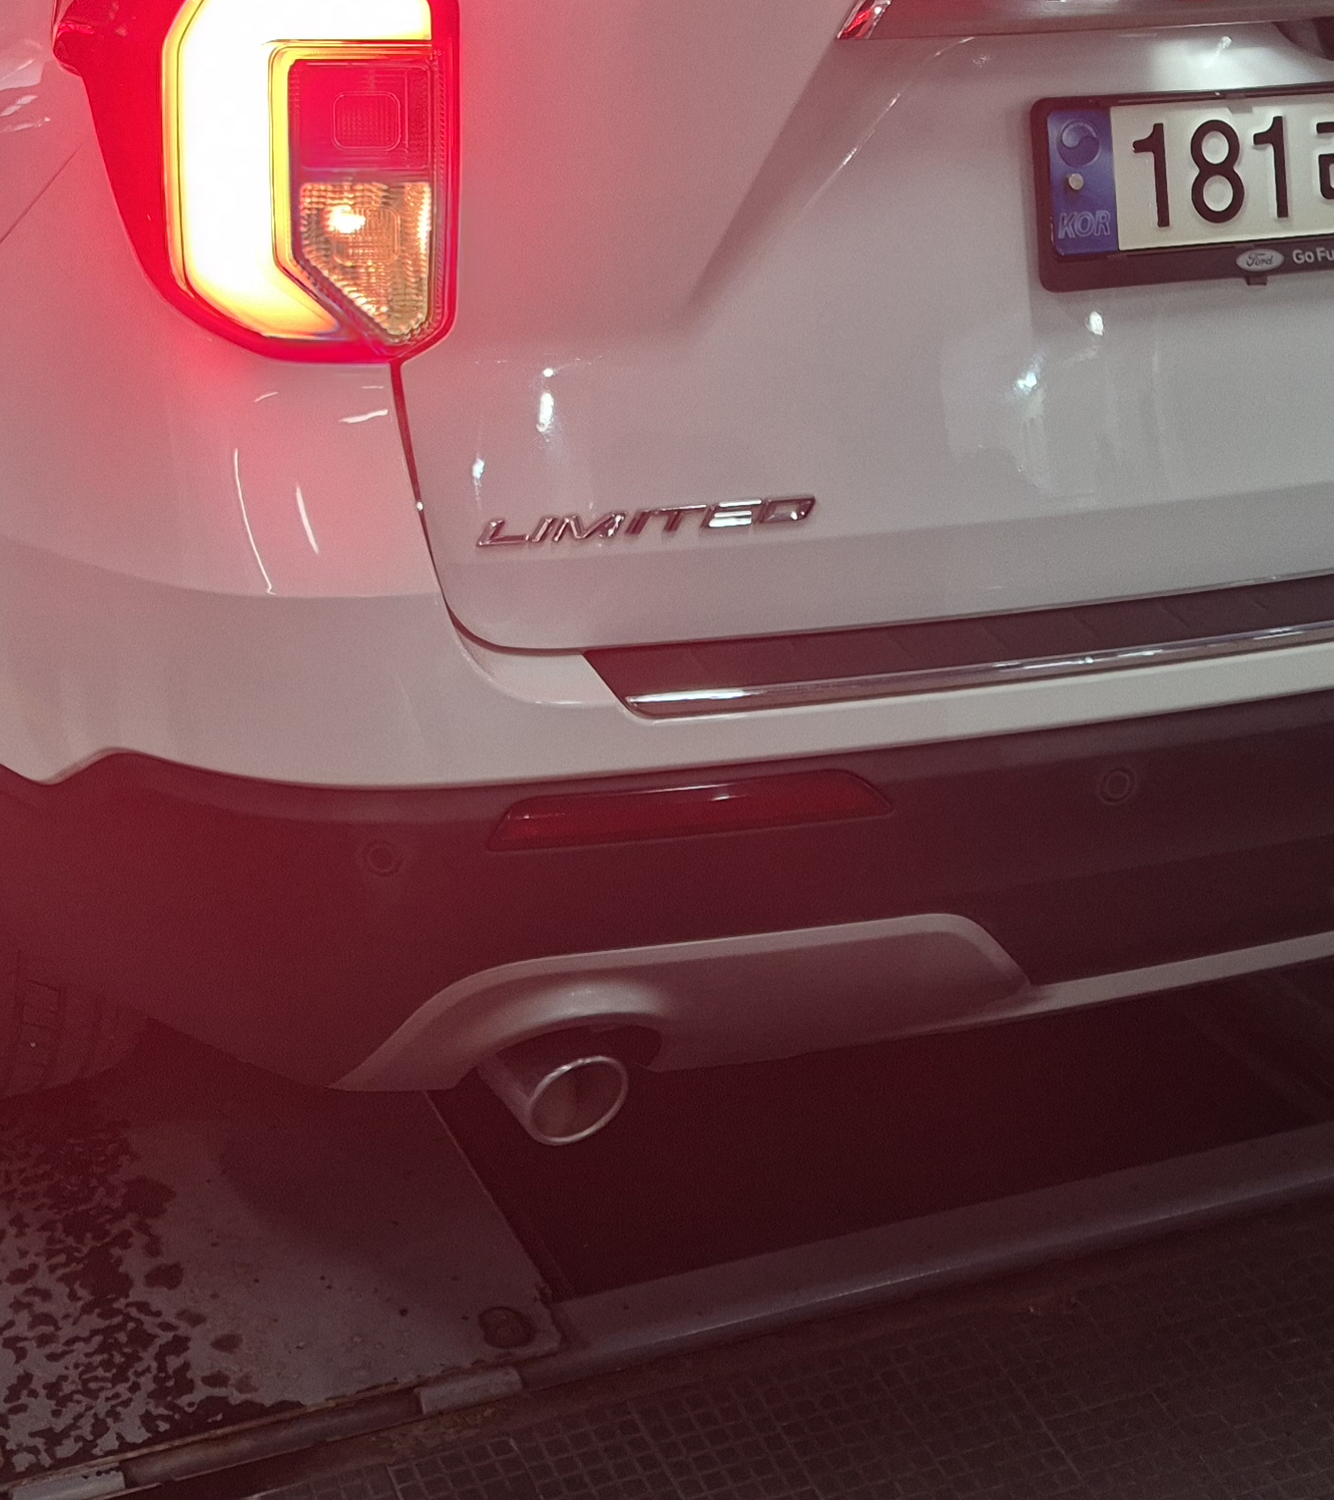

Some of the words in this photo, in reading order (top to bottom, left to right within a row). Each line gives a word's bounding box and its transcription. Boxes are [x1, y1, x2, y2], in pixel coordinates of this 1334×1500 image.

[1058, 210, 1111, 239] KOR
[1245, 252, 1274, 267] Ford
[1292, 249, 1315, 264] Go
[476, 494, 816, 547] LIMITED
